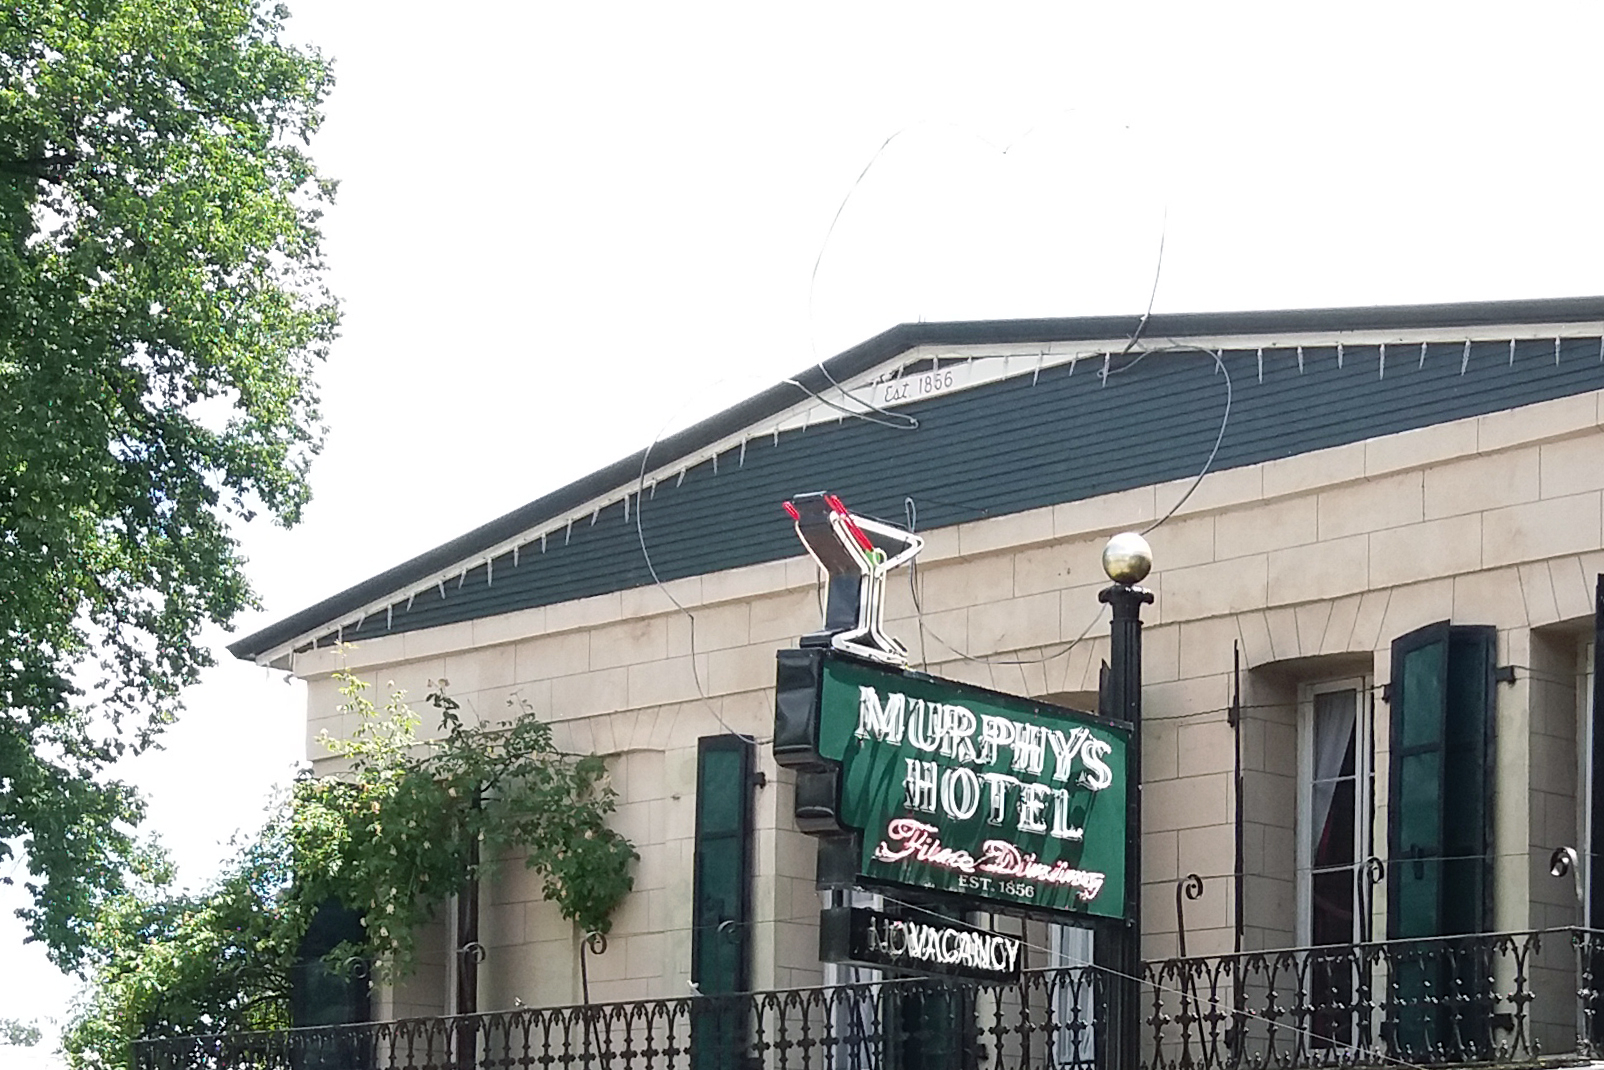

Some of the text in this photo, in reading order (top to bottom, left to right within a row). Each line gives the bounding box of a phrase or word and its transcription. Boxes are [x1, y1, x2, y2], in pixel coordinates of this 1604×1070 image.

[918, 371, 954, 394] 1856
[902, 757, 1084, 841] HOTEL
[871, 818, 1106, 901] Fine Dining
[958, 874, 1035, 899] EST. 1856
[867, 916, 1021, 973] NO VACANCY
